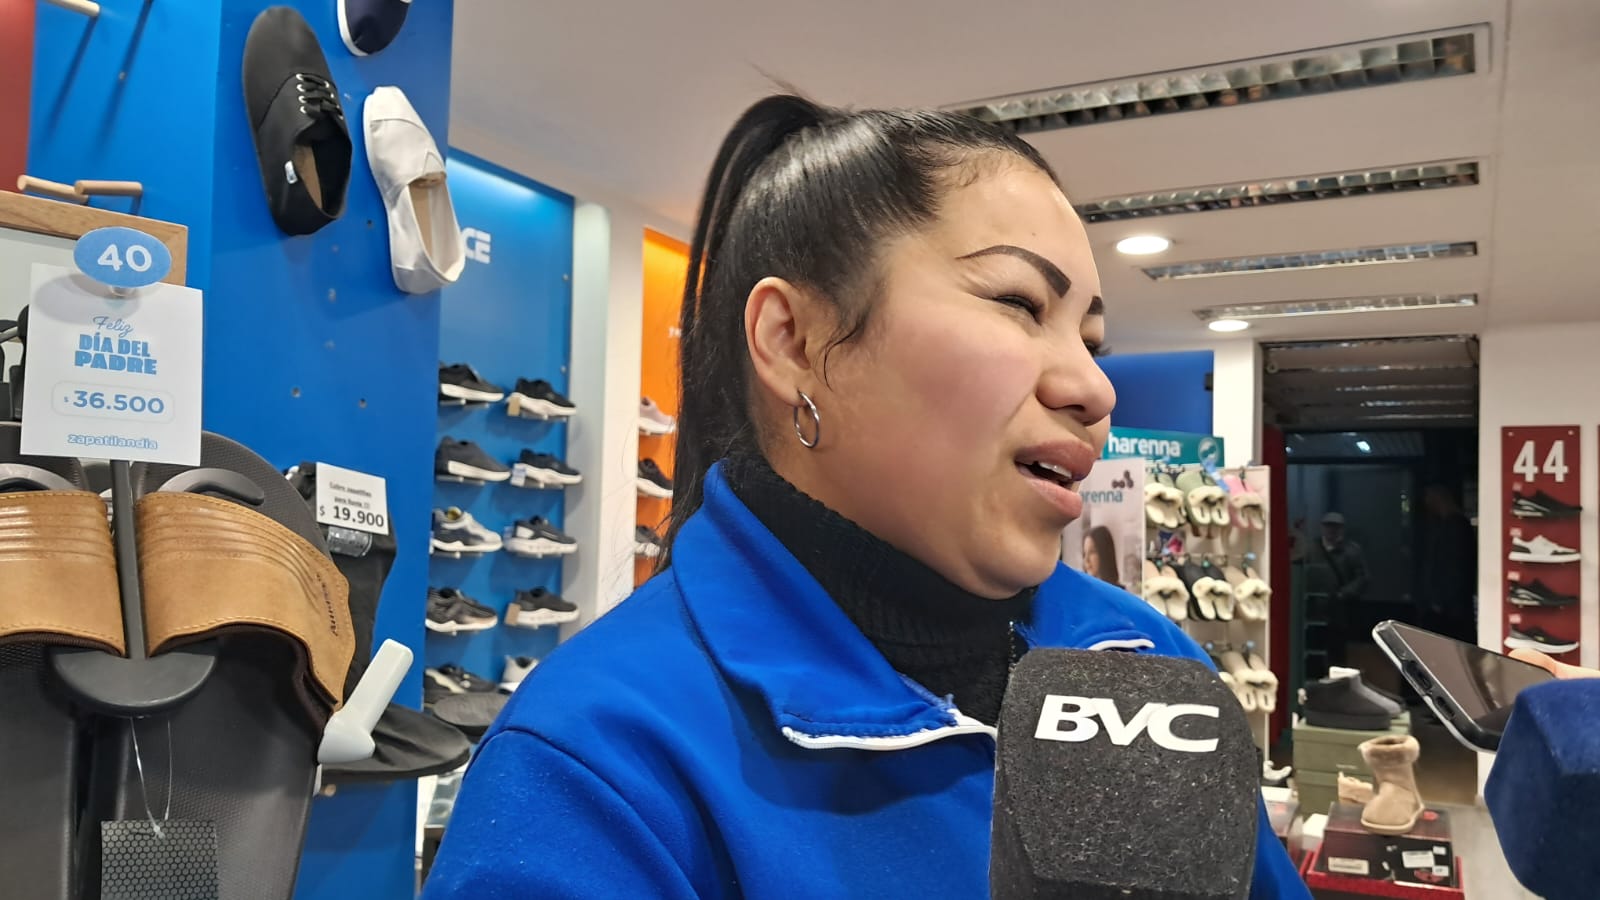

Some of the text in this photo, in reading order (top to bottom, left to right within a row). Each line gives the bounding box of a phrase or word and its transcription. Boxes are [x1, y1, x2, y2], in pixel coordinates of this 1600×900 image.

[97, 244, 152, 272] 40
[93, 315, 134, 338] Feliz
[79, 332, 151, 357] DÍA DEL
[75, 350, 157, 375] PADRE
[73, 390, 164, 414] 36.500
[67, 434, 158, 450] zapatilandia
[1108, 431, 1182, 457] harenna
[1512, 440, 1569, 483] 44
[319, 505, 384, 527] $ 19.900
[1034, 694, 1220, 753] BVC
